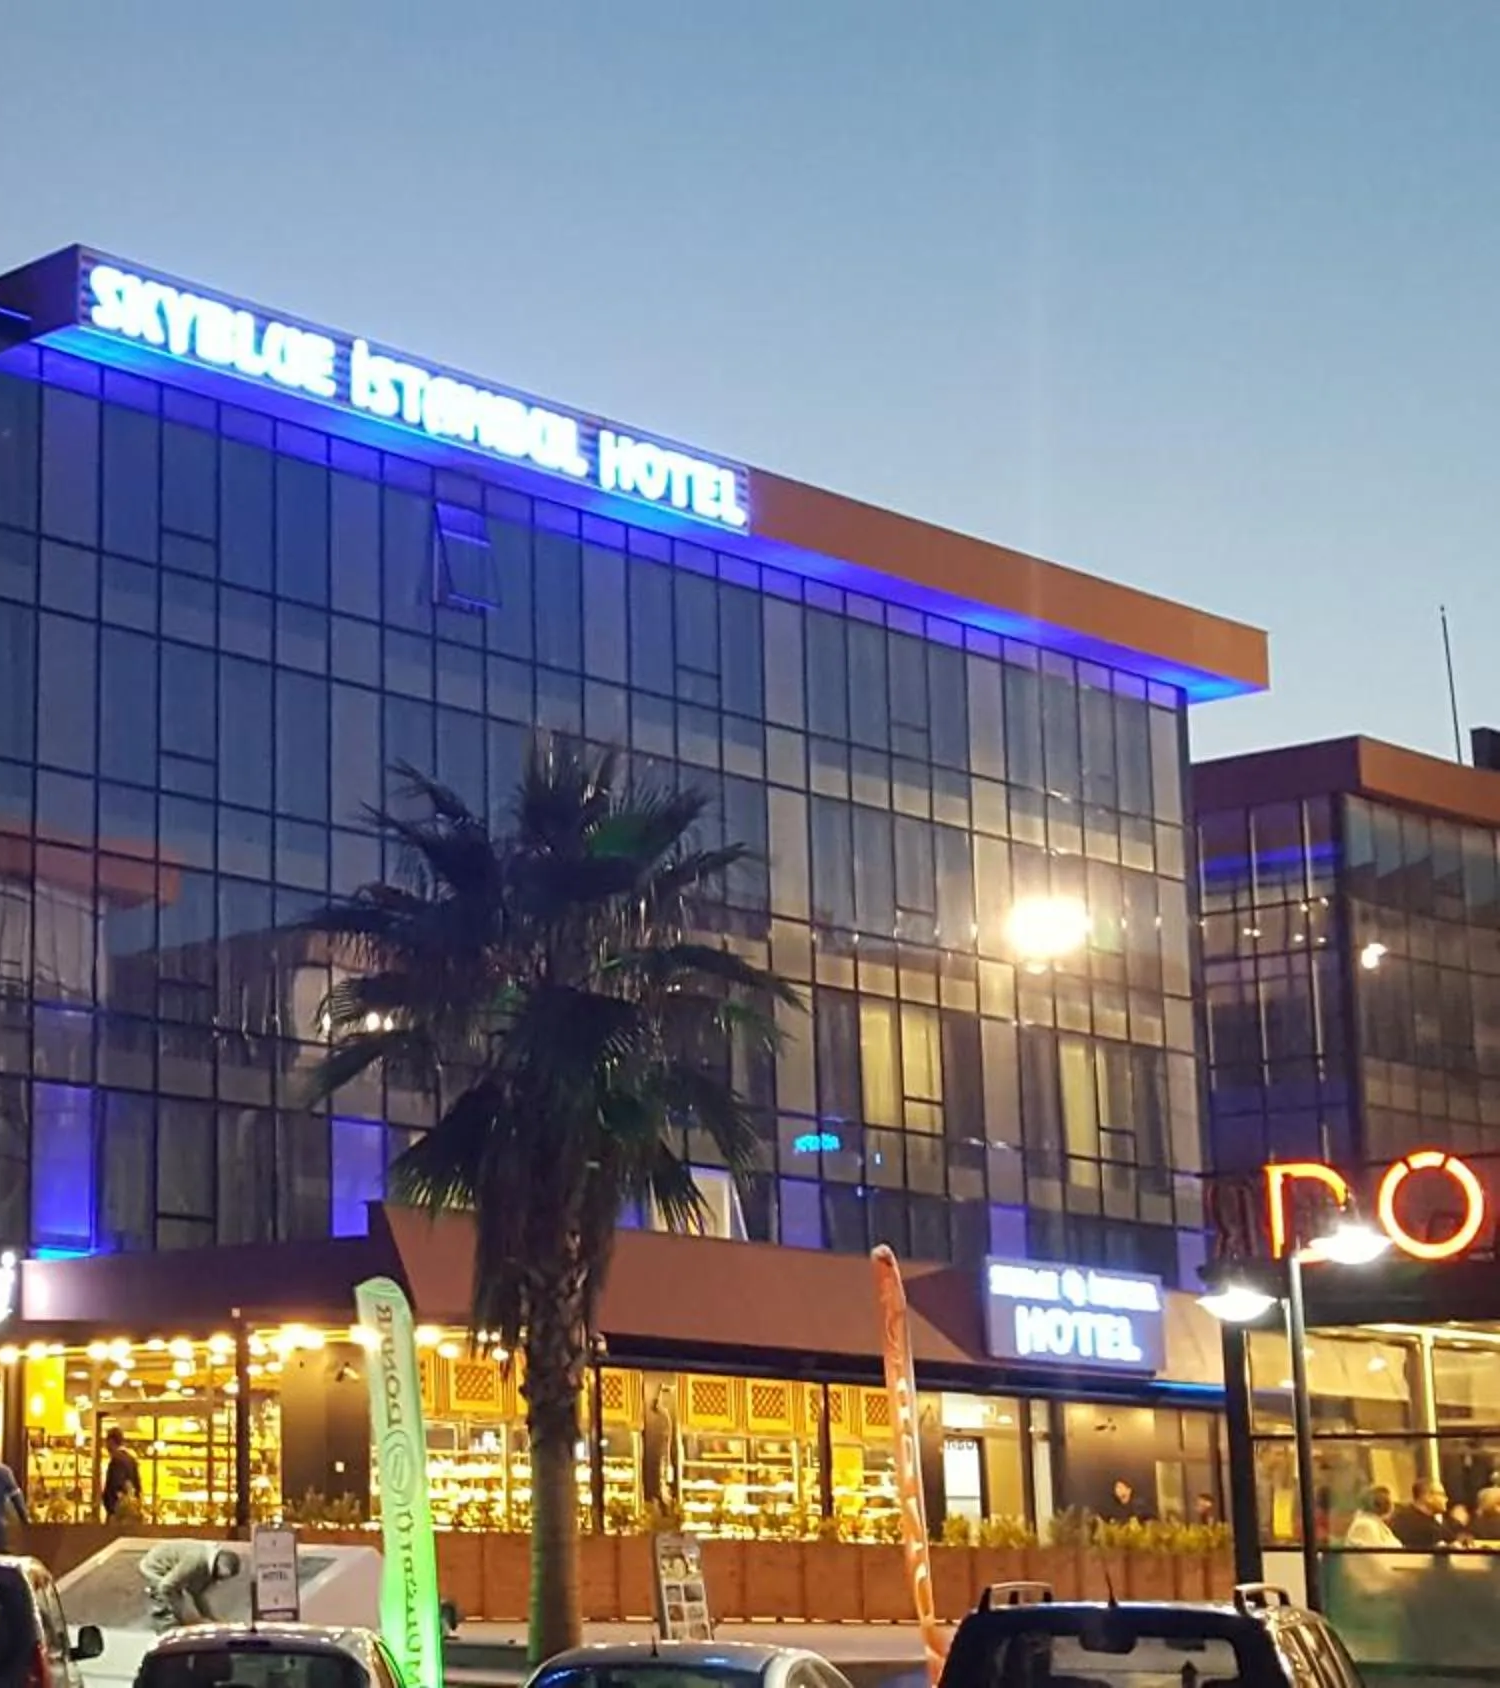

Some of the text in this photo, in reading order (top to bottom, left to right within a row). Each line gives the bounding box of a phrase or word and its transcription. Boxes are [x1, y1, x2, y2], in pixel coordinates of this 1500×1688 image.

[89, 266, 336, 397] SKYBLUE
[598, 429, 747, 526] HOTEL
[1015, 1304, 1142, 1361] HOTEL
